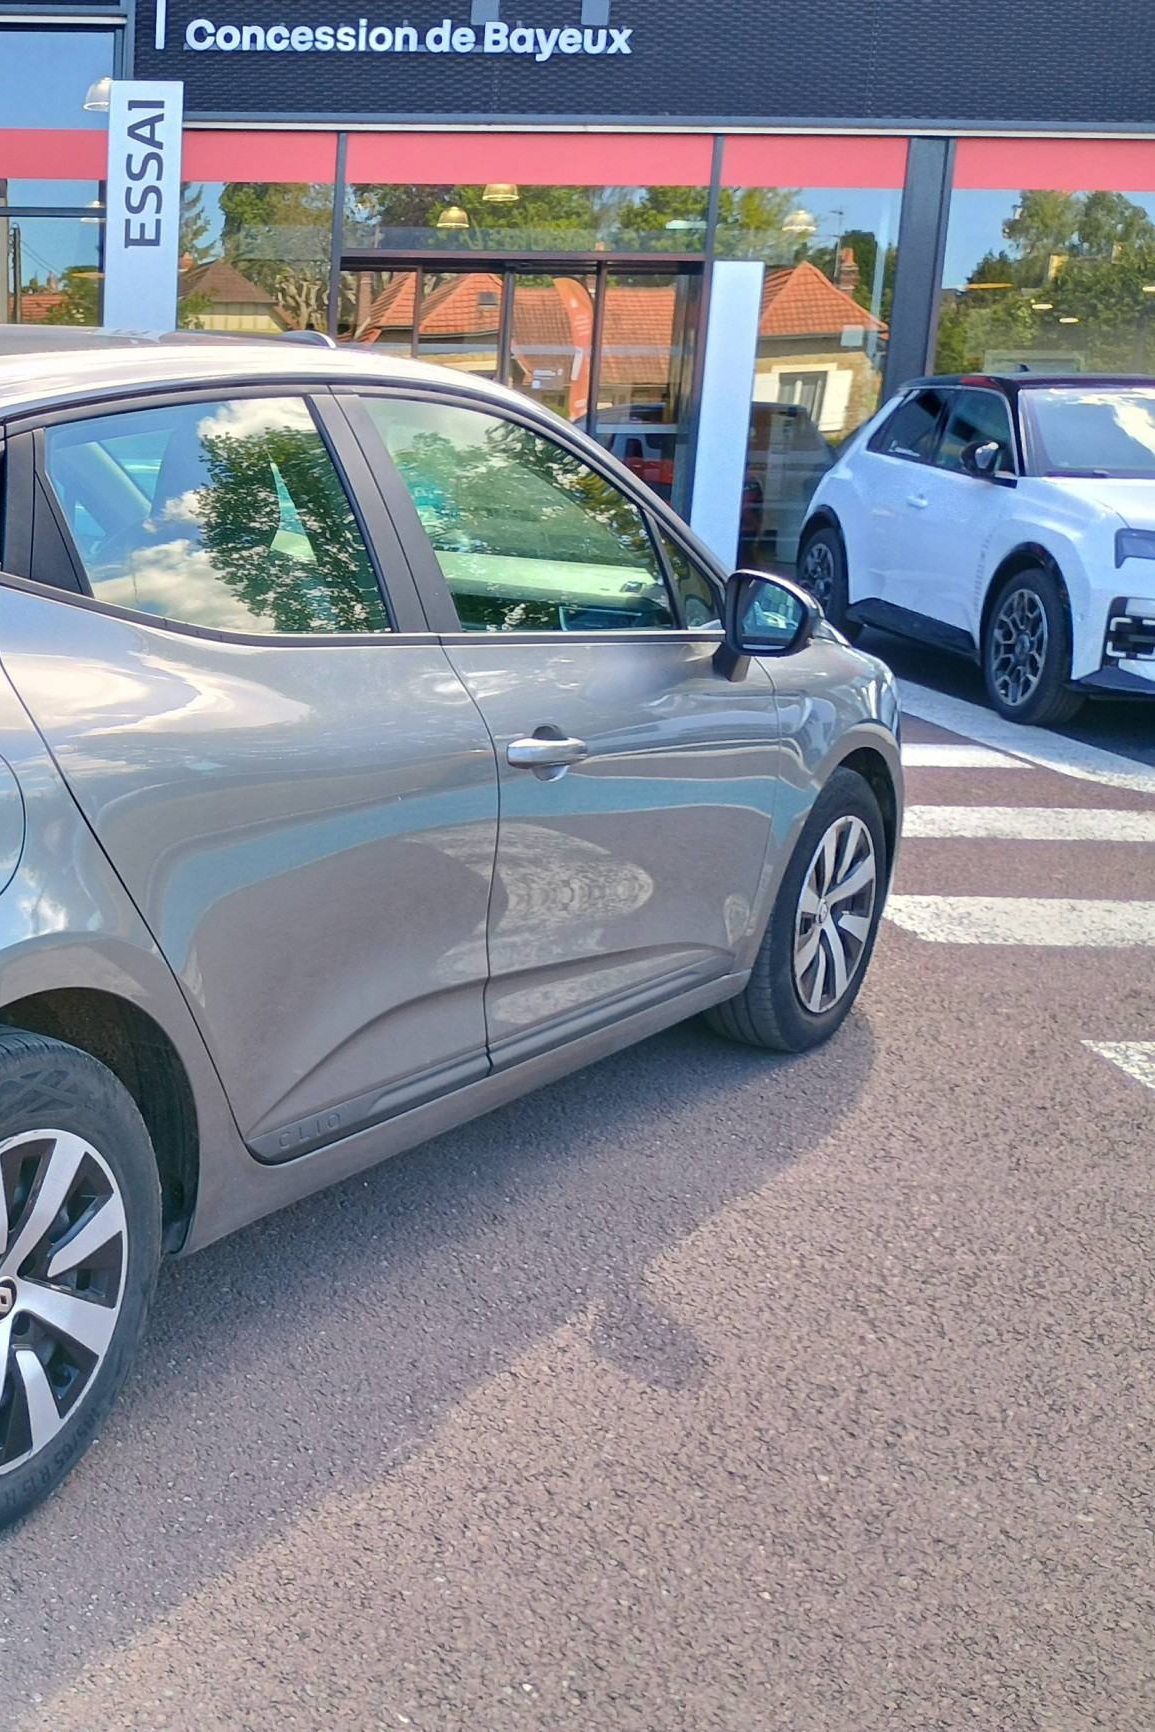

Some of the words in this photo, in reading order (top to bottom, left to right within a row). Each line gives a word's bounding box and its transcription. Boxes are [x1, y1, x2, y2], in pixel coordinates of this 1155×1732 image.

[185, 18, 418, 52] Concession
[425, 19, 476, 53] de
[483, 21, 633, 62] Bayeux
[124, 100, 165, 248] ESSAI
[279, 1113, 340, 1149] CLIO
